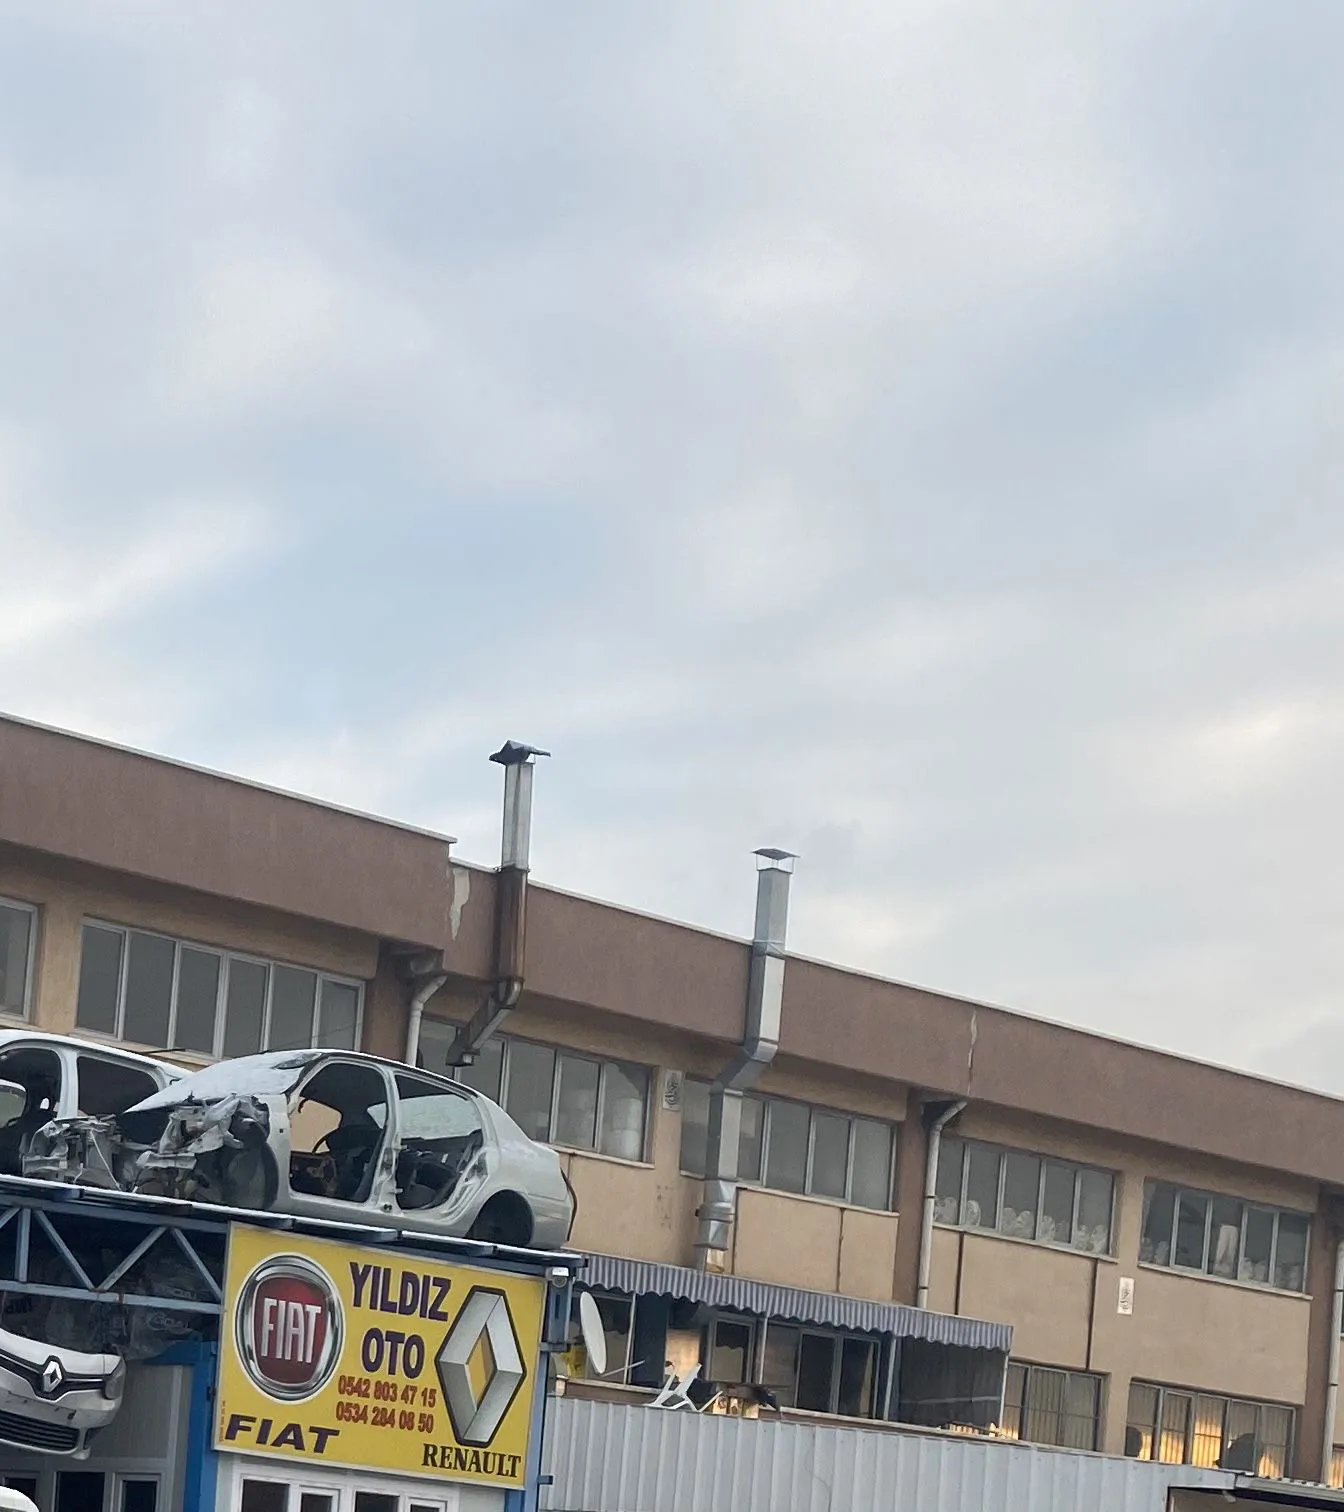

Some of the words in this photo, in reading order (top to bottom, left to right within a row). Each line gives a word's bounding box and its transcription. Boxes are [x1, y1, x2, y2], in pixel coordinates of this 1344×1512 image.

[349, 1262, 452, 1322] YILDIZ
[261, 1297, 322, 1364] FIAT
[362, 1328, 425, 1379] OTO
[338, 1375, 371, 1399] 0542
[401, 1382, 419, 1406] 47
[422, 1387, 437, 1408] 15
[224, 1414, 340, 1454] FIAT
[335, 1401, 369, 1425] 0534
[418, 1412, 434, 1434] 50
[422, 1442, 522, 1478] RENAULT
